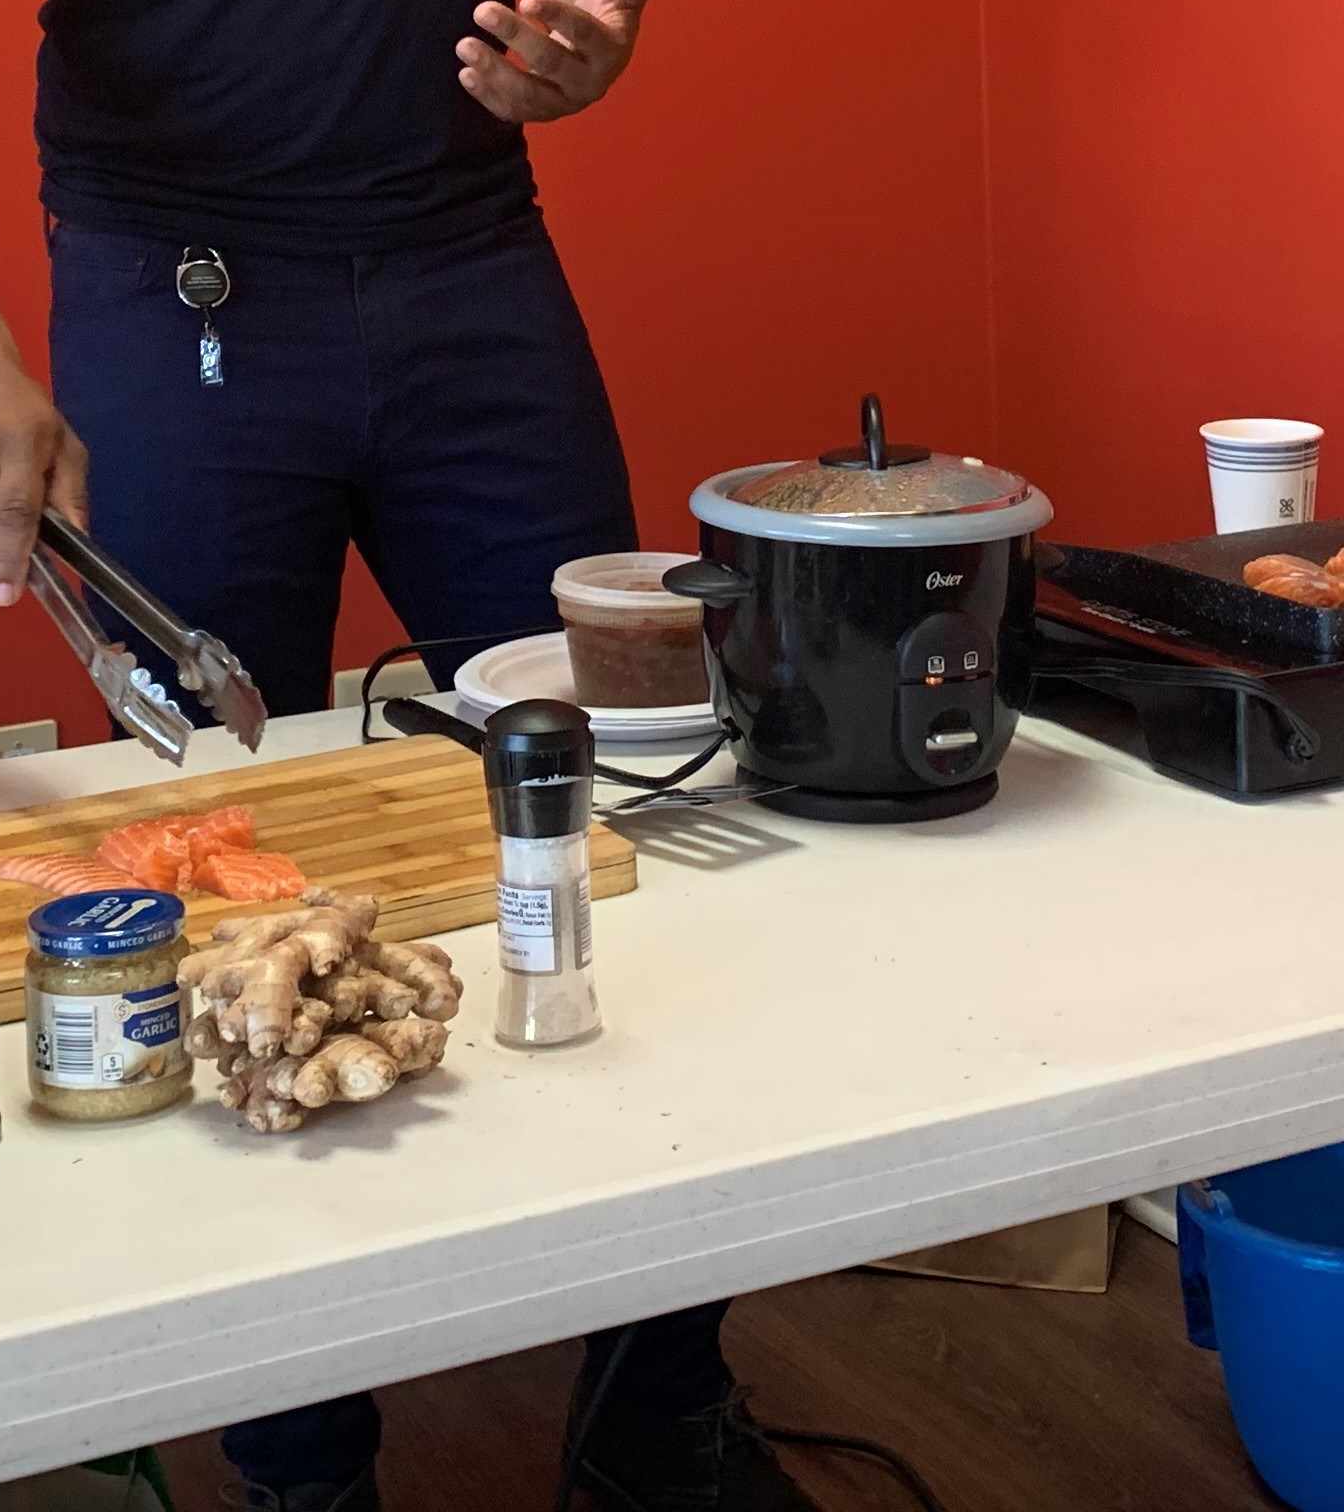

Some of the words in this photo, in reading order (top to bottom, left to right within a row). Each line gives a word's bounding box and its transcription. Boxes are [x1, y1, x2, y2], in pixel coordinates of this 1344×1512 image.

[926, 571, 964, 590] Oster
[51, 940, 84, 951] GARLIC
[107, 937, 144, 950] MINCED
[140, 1011, 171, 1027] MINCED
[131, 1016, 177, 1040] GARLIC
